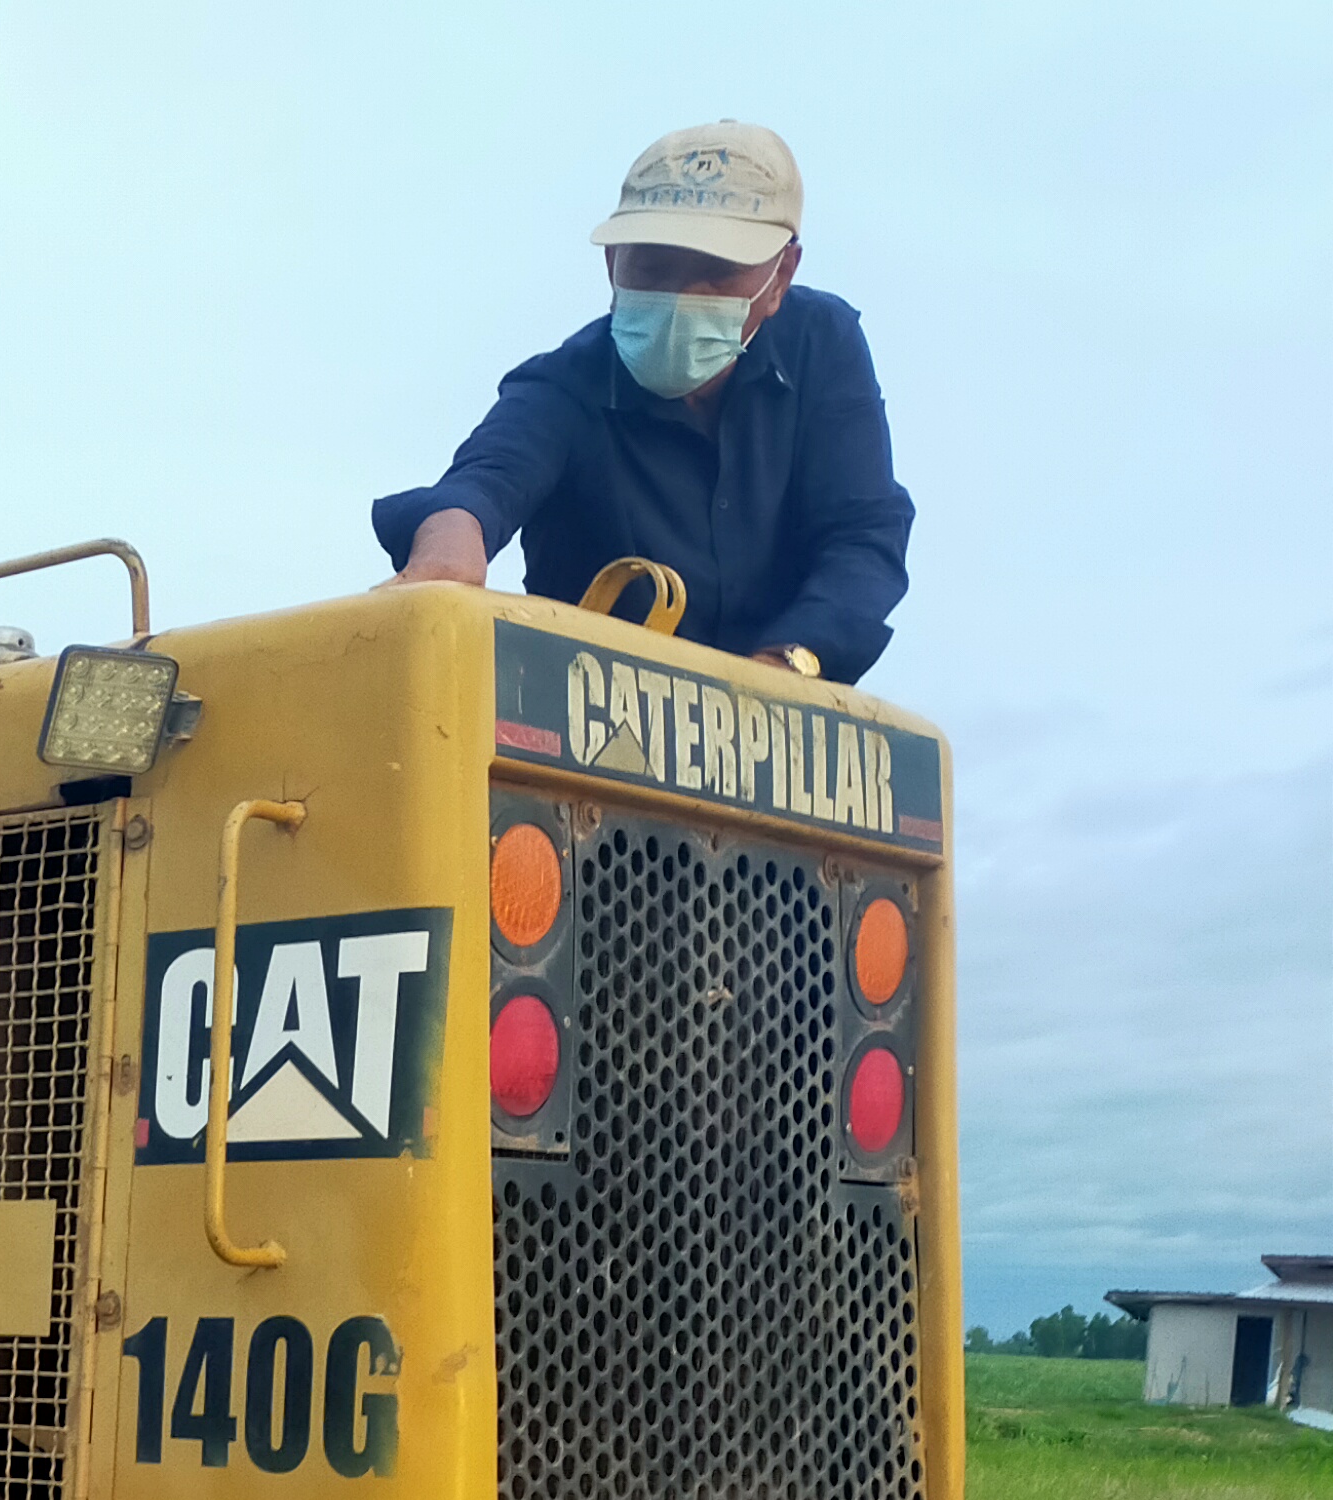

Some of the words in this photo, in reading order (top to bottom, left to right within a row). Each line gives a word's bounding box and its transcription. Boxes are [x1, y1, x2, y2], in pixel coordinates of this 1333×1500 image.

[568, 651, 894, 834] CATERPILLAR
[154, 930, 430, 1140] CAT
[122, 1314, 404, 1478] 140G
